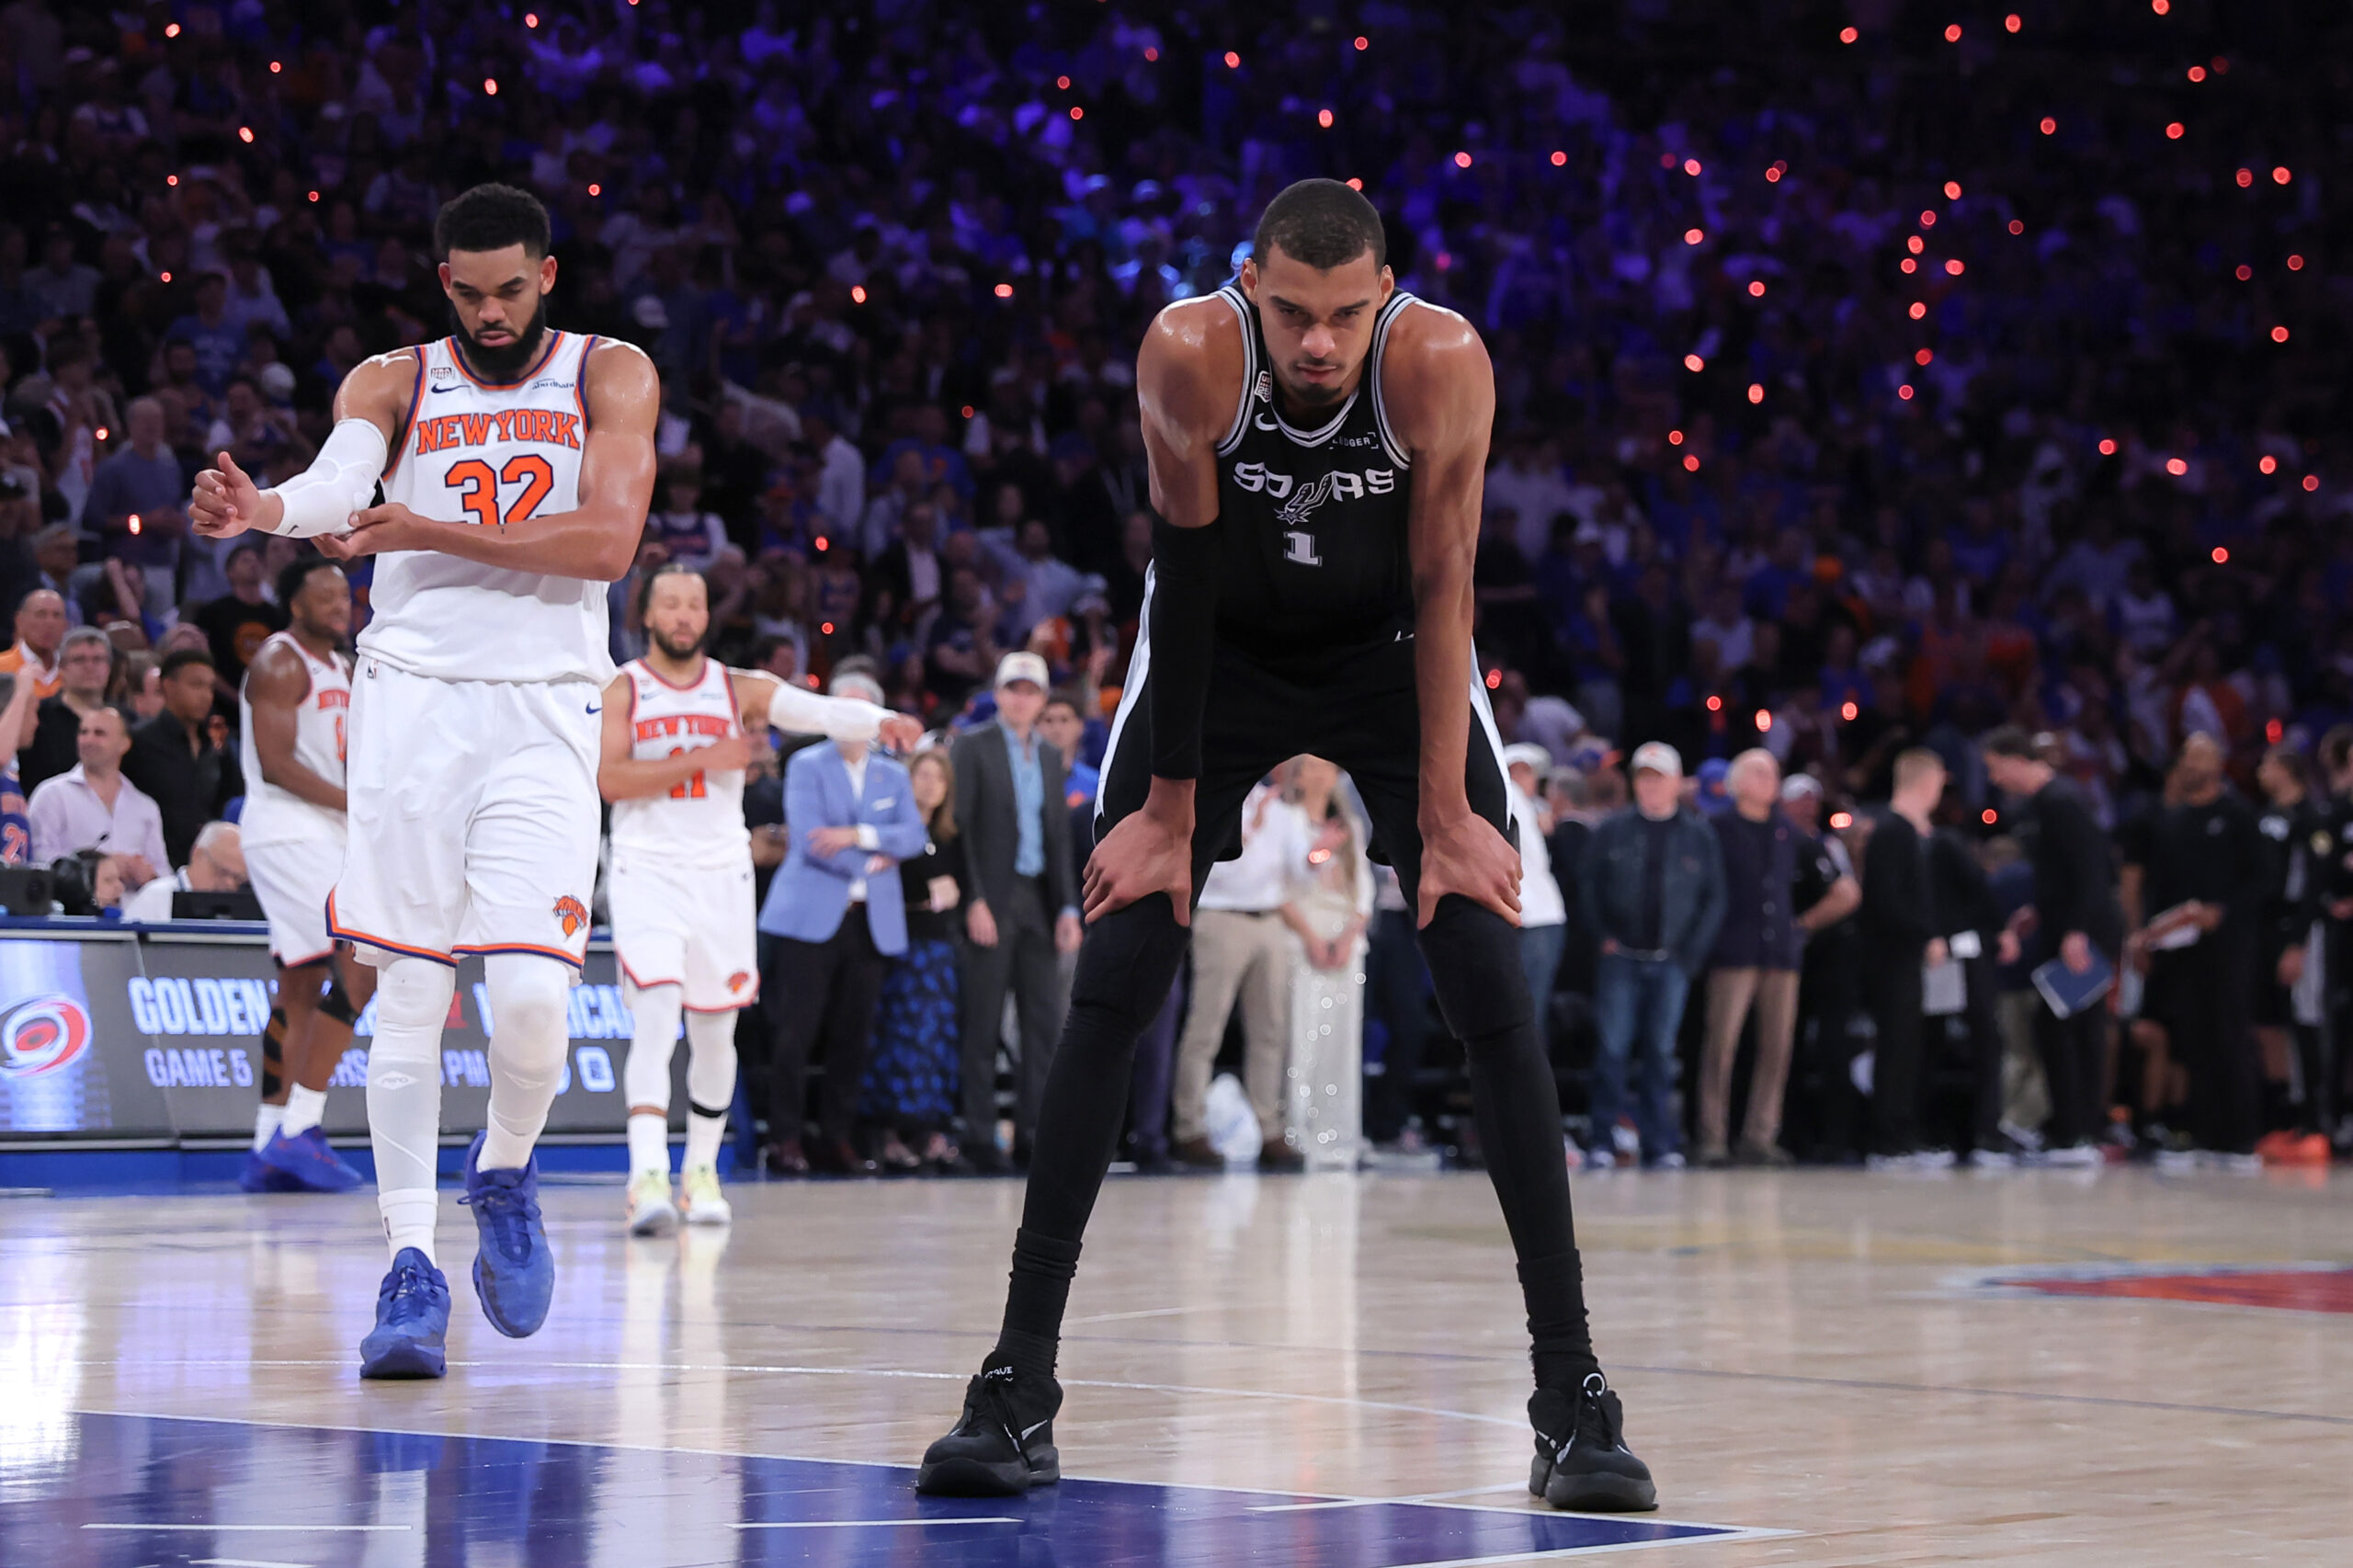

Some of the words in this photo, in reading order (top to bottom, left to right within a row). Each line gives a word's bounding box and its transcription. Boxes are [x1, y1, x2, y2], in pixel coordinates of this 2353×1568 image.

[416, 413, 493, 455] NEW
[493, 409, 580, 449] YORK
[1332, 437, 1370, 447] LDGER
[445, 454, 554, 525] 32
[1283, 530, 1323, 567] 1
[128, 976, 272, 1036] GOLDEN
[144, 1049, 229, 1087] GAME
[230, 1049, 254, 1087] 5
